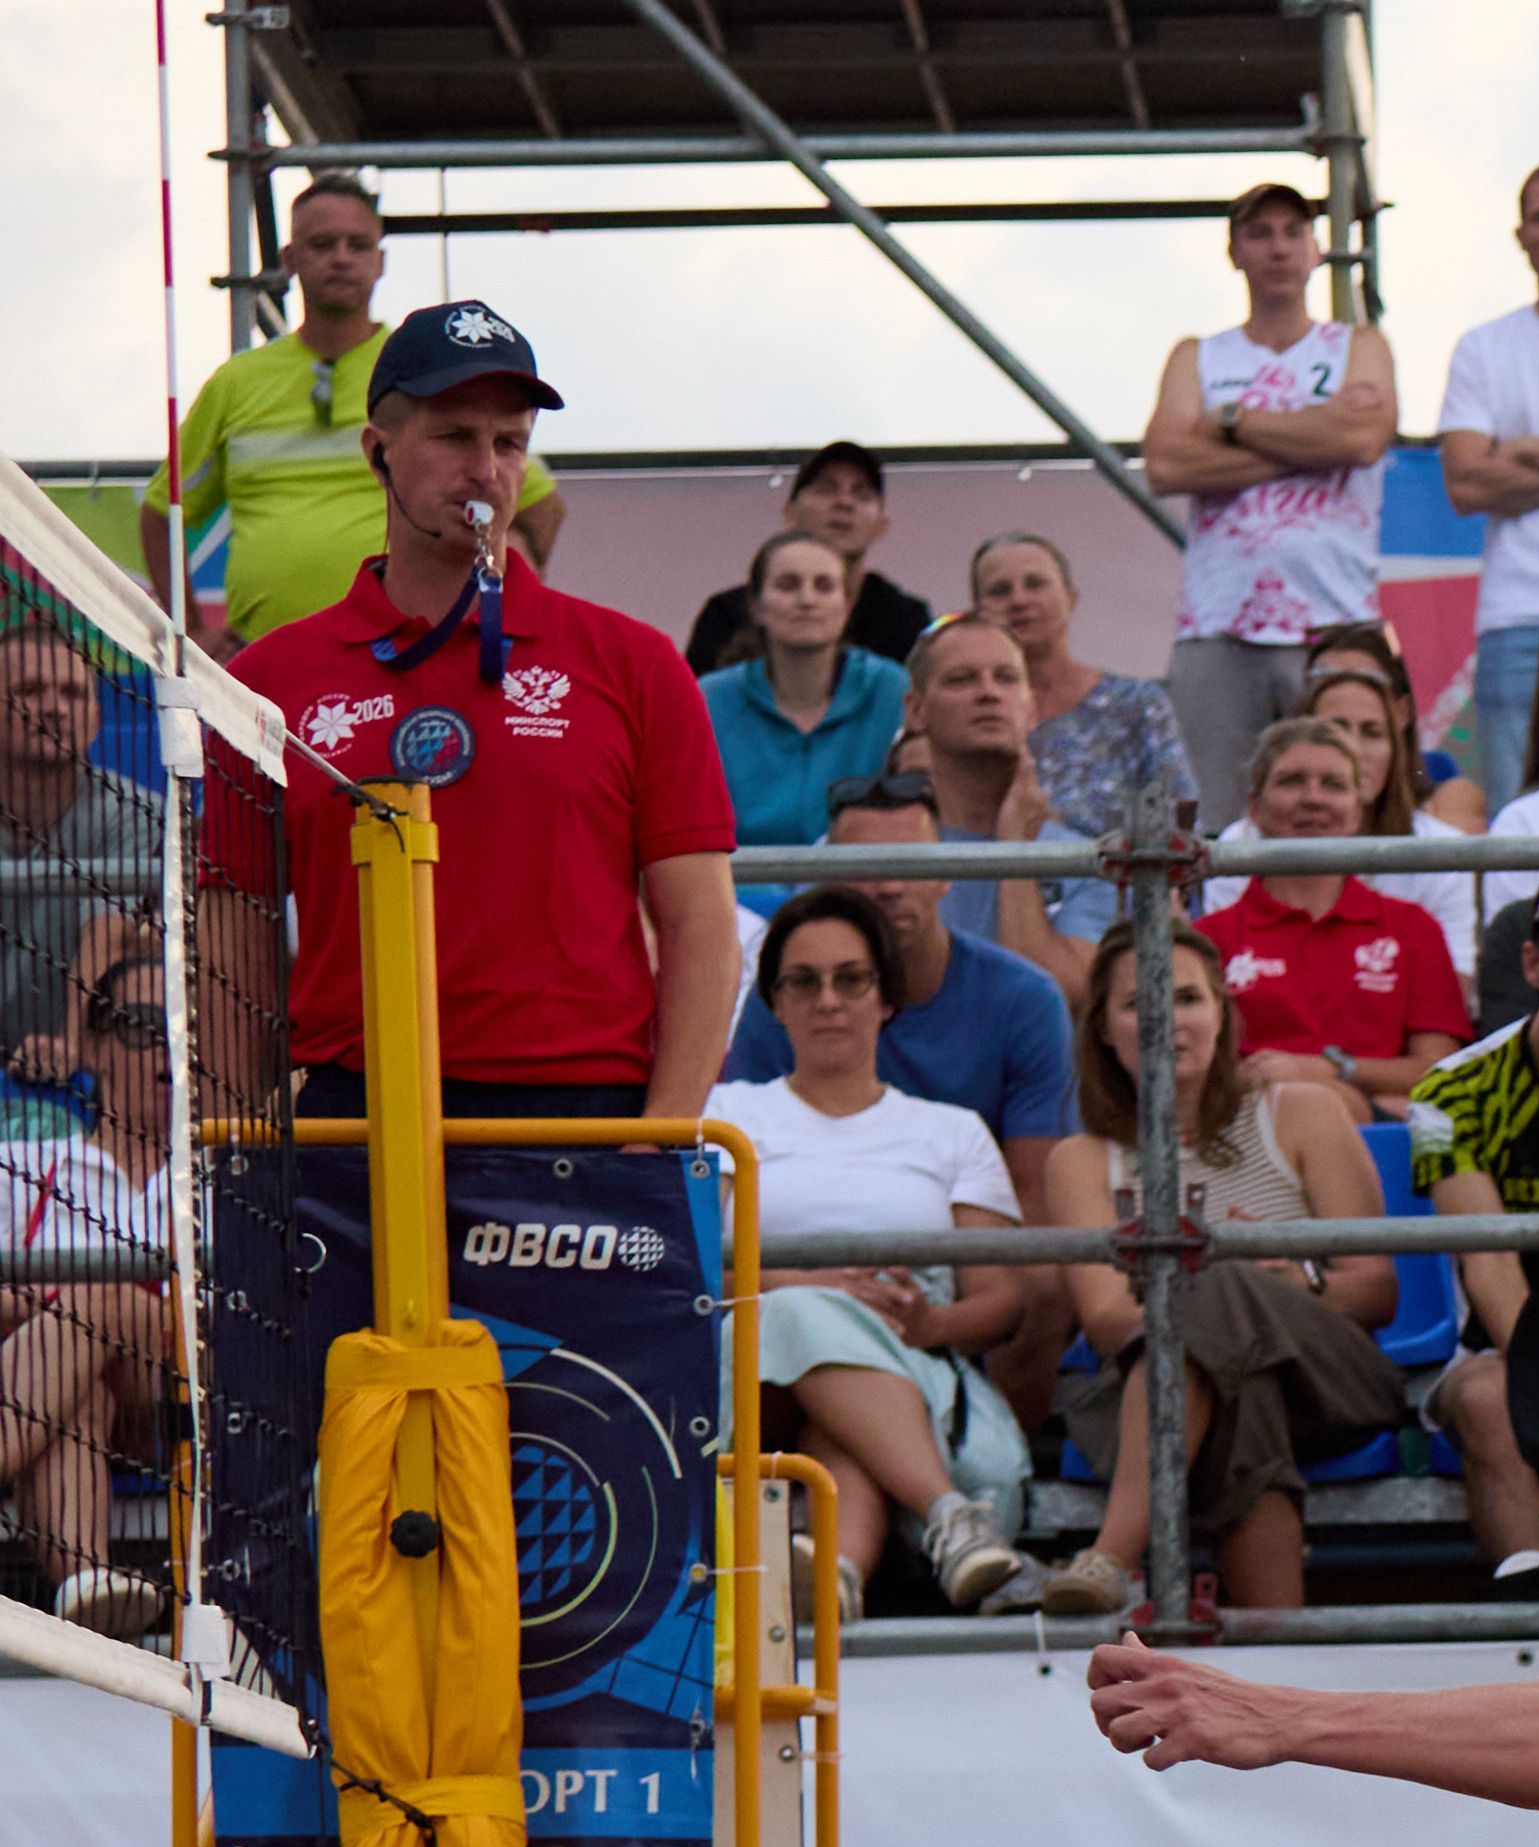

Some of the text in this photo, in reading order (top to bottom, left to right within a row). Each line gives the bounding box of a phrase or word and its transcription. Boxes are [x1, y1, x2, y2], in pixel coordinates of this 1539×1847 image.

[1311, 362, 1332, 396] 2
[352, 694, 395, 725] 2026
[463, 1222, 618, 1270] ФВСО
[520, 1769, 661, 1814] ОРТ 1
